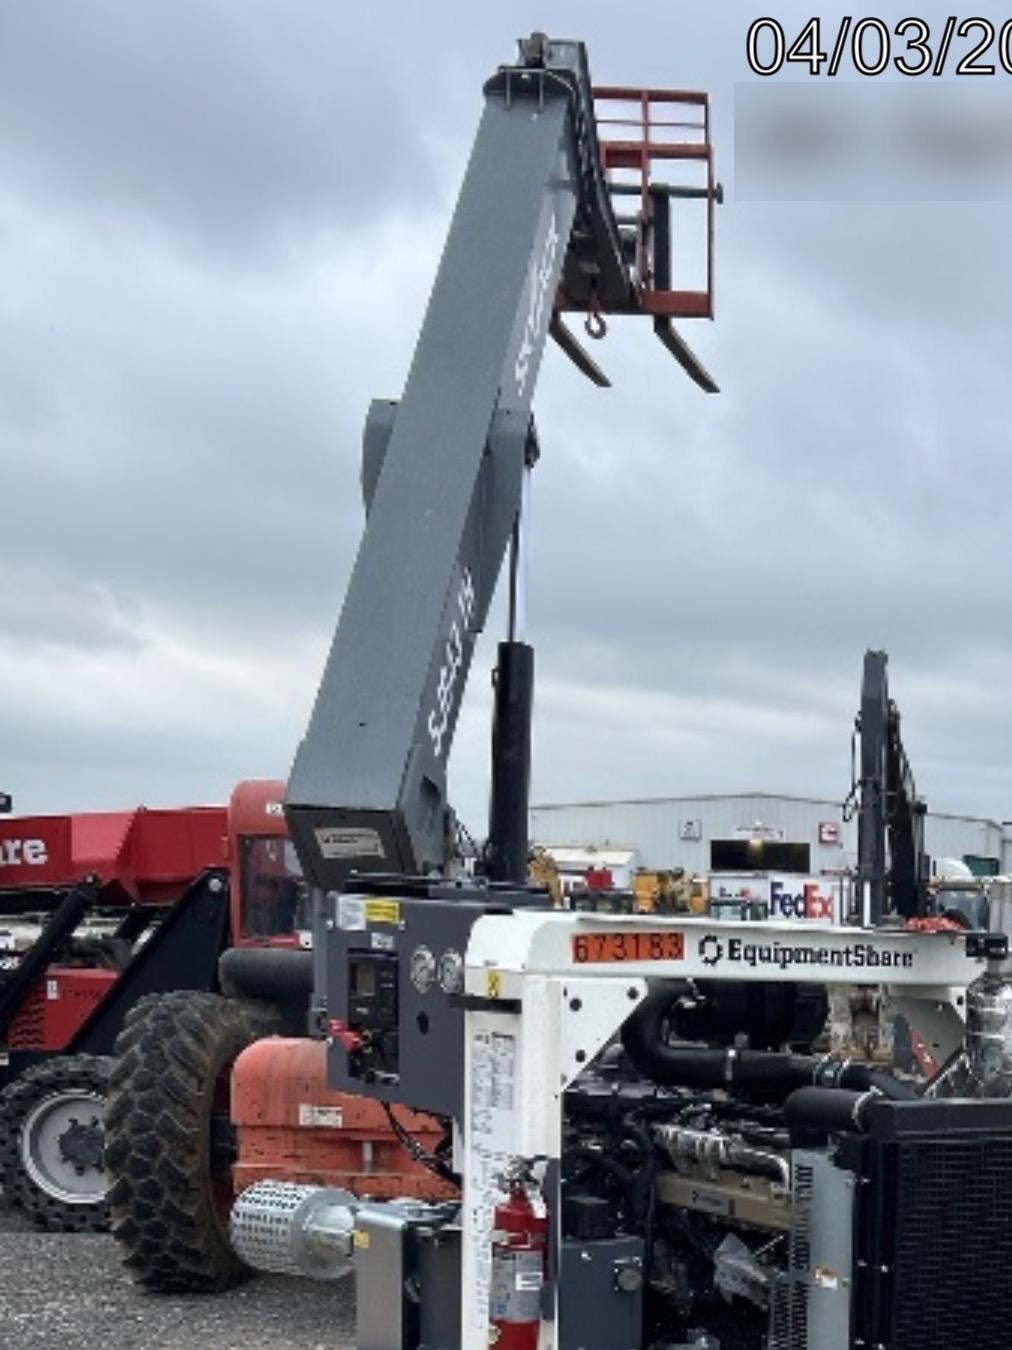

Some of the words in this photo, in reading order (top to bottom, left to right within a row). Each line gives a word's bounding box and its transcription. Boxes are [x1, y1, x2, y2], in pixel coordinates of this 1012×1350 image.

[769, 881, 834, 918] FedEx
[573, 933, 684, 963] 673183
[727, 938, 914, 970] EquipmentShare
